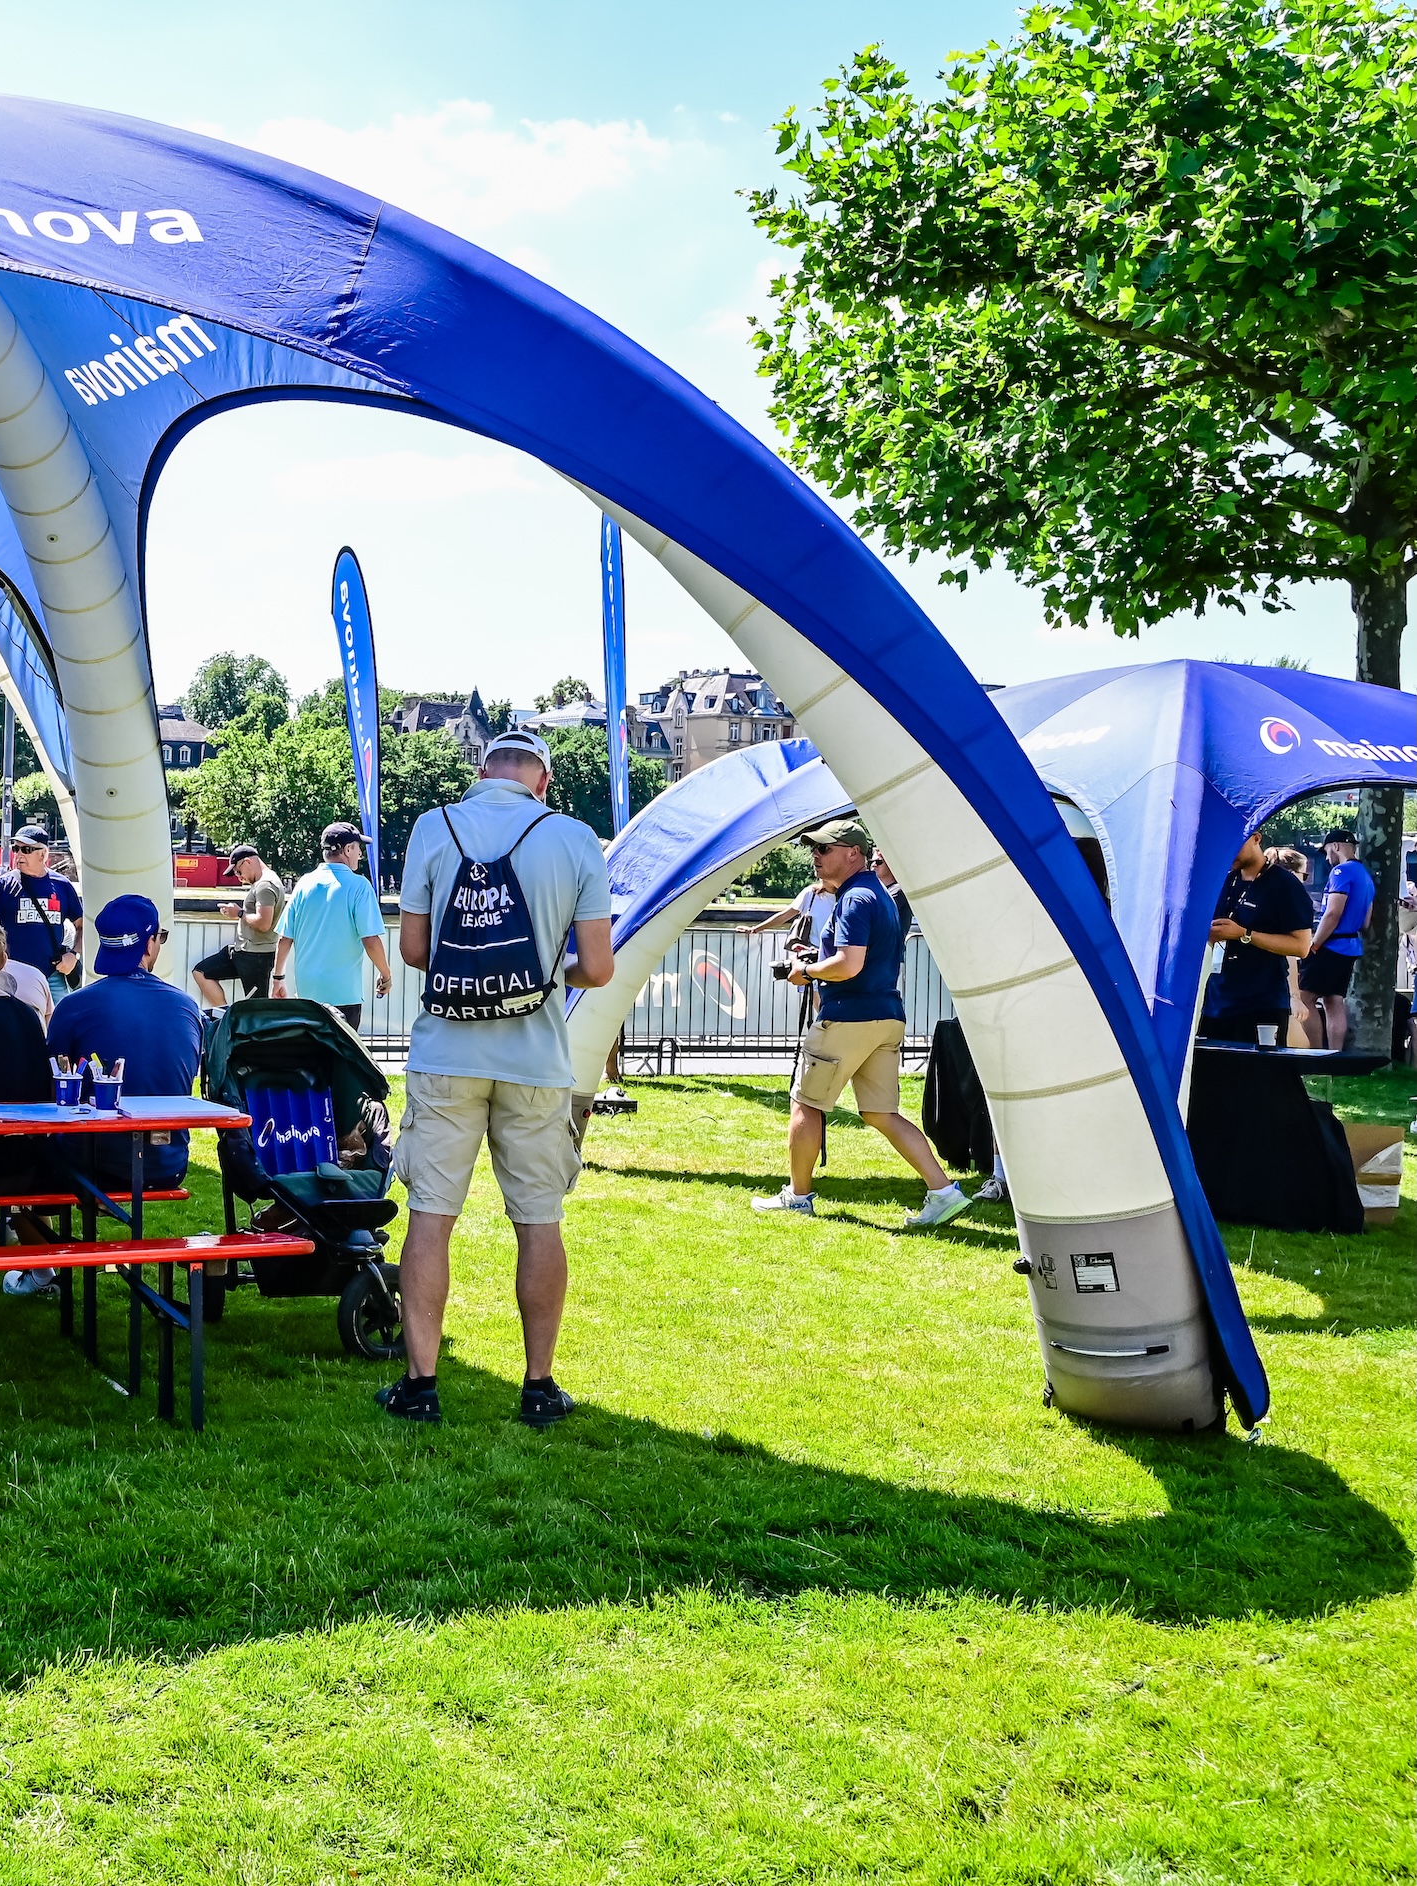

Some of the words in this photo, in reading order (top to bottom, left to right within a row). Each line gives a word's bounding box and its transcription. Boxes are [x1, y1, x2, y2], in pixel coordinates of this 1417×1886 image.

[454, 884, 515, 911] EUROPA
[433, 970, 536, 996] OFFICIAL
[276, 1125, 320, 1143] mainova
